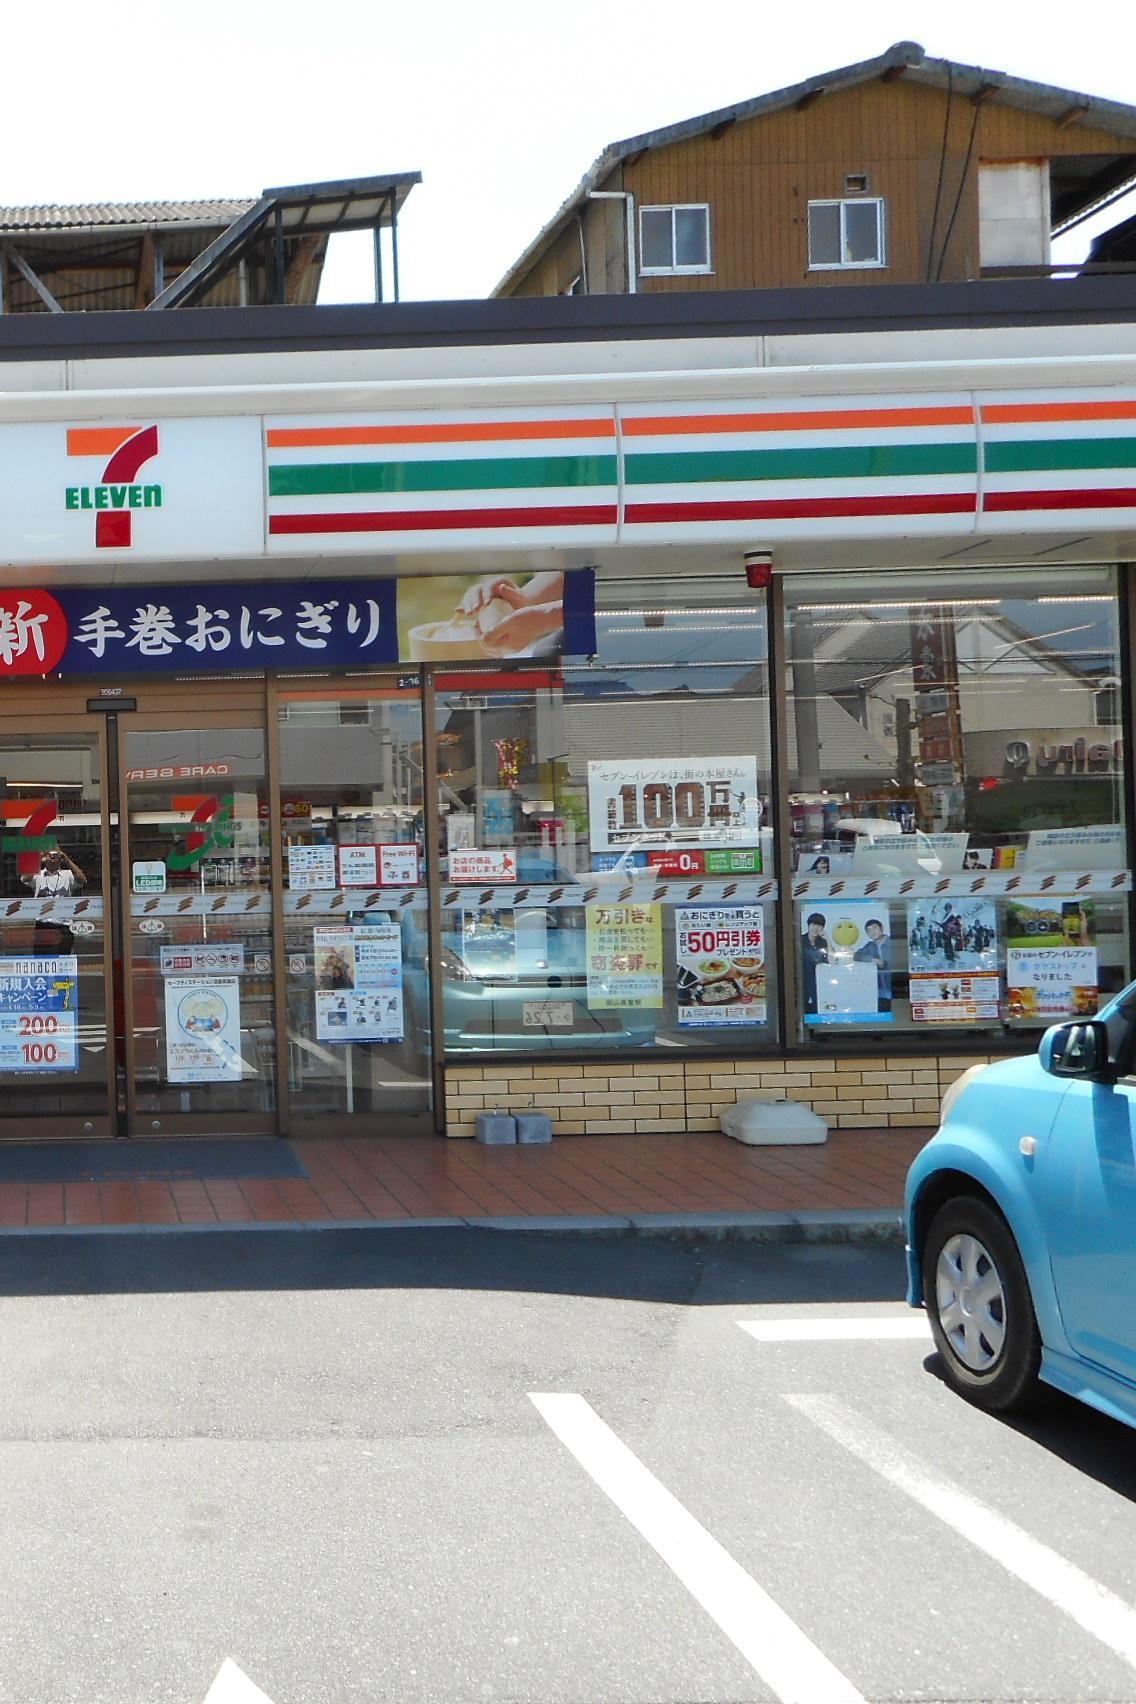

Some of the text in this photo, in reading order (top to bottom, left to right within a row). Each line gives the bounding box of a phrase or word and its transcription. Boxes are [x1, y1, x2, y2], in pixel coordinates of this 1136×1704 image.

[65, 485, 162, 510] ELEVEN
[72, 599, 381, 659] 手巻おにぎり
[15, 961, 58, 974] nanaco
[0, 992, 47, 1003] キャンペーン
